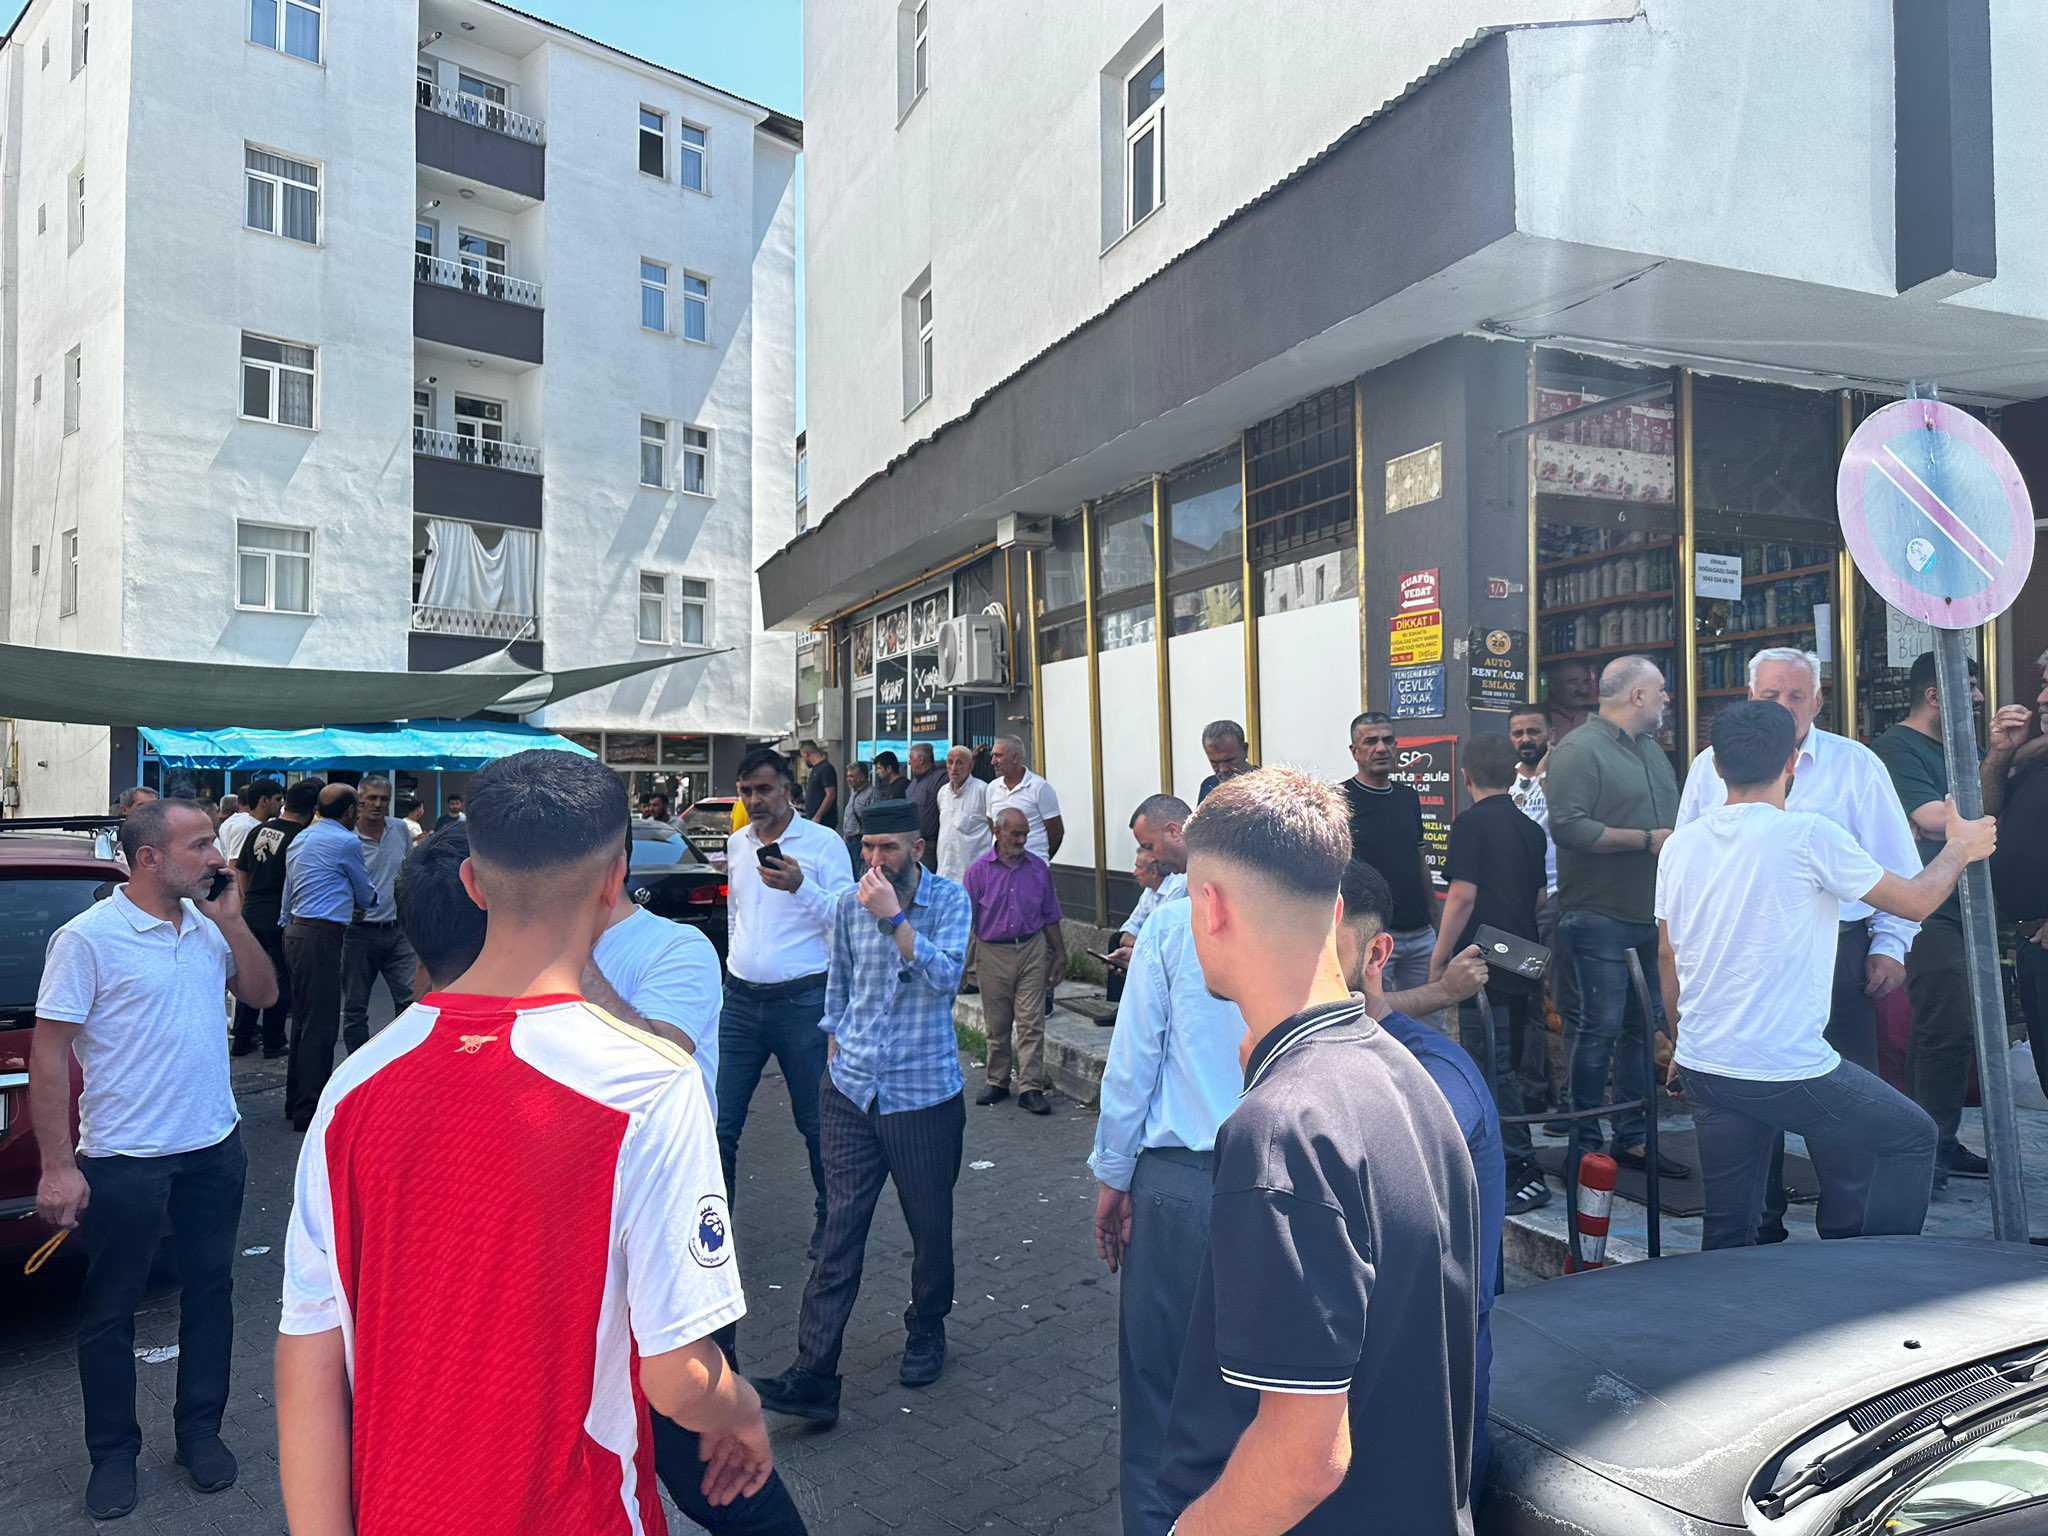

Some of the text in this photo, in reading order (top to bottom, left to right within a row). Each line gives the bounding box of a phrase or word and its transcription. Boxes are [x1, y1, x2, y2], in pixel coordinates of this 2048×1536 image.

[1401, 571, 1436, 592] KUAFÖR
[1404, 585, 1433, 599] VEDAT
[1396, 615, 1428, 631] DİKKAT
[1484, 658, 1512, 668] AUTO
[1482, 680, 1516, 691] EMLAK
[1400, 693, 1431, 705] SOKAK
[1388, 770, 1450, 783] antapaula
[261, 829, 281, 841] BOSS
